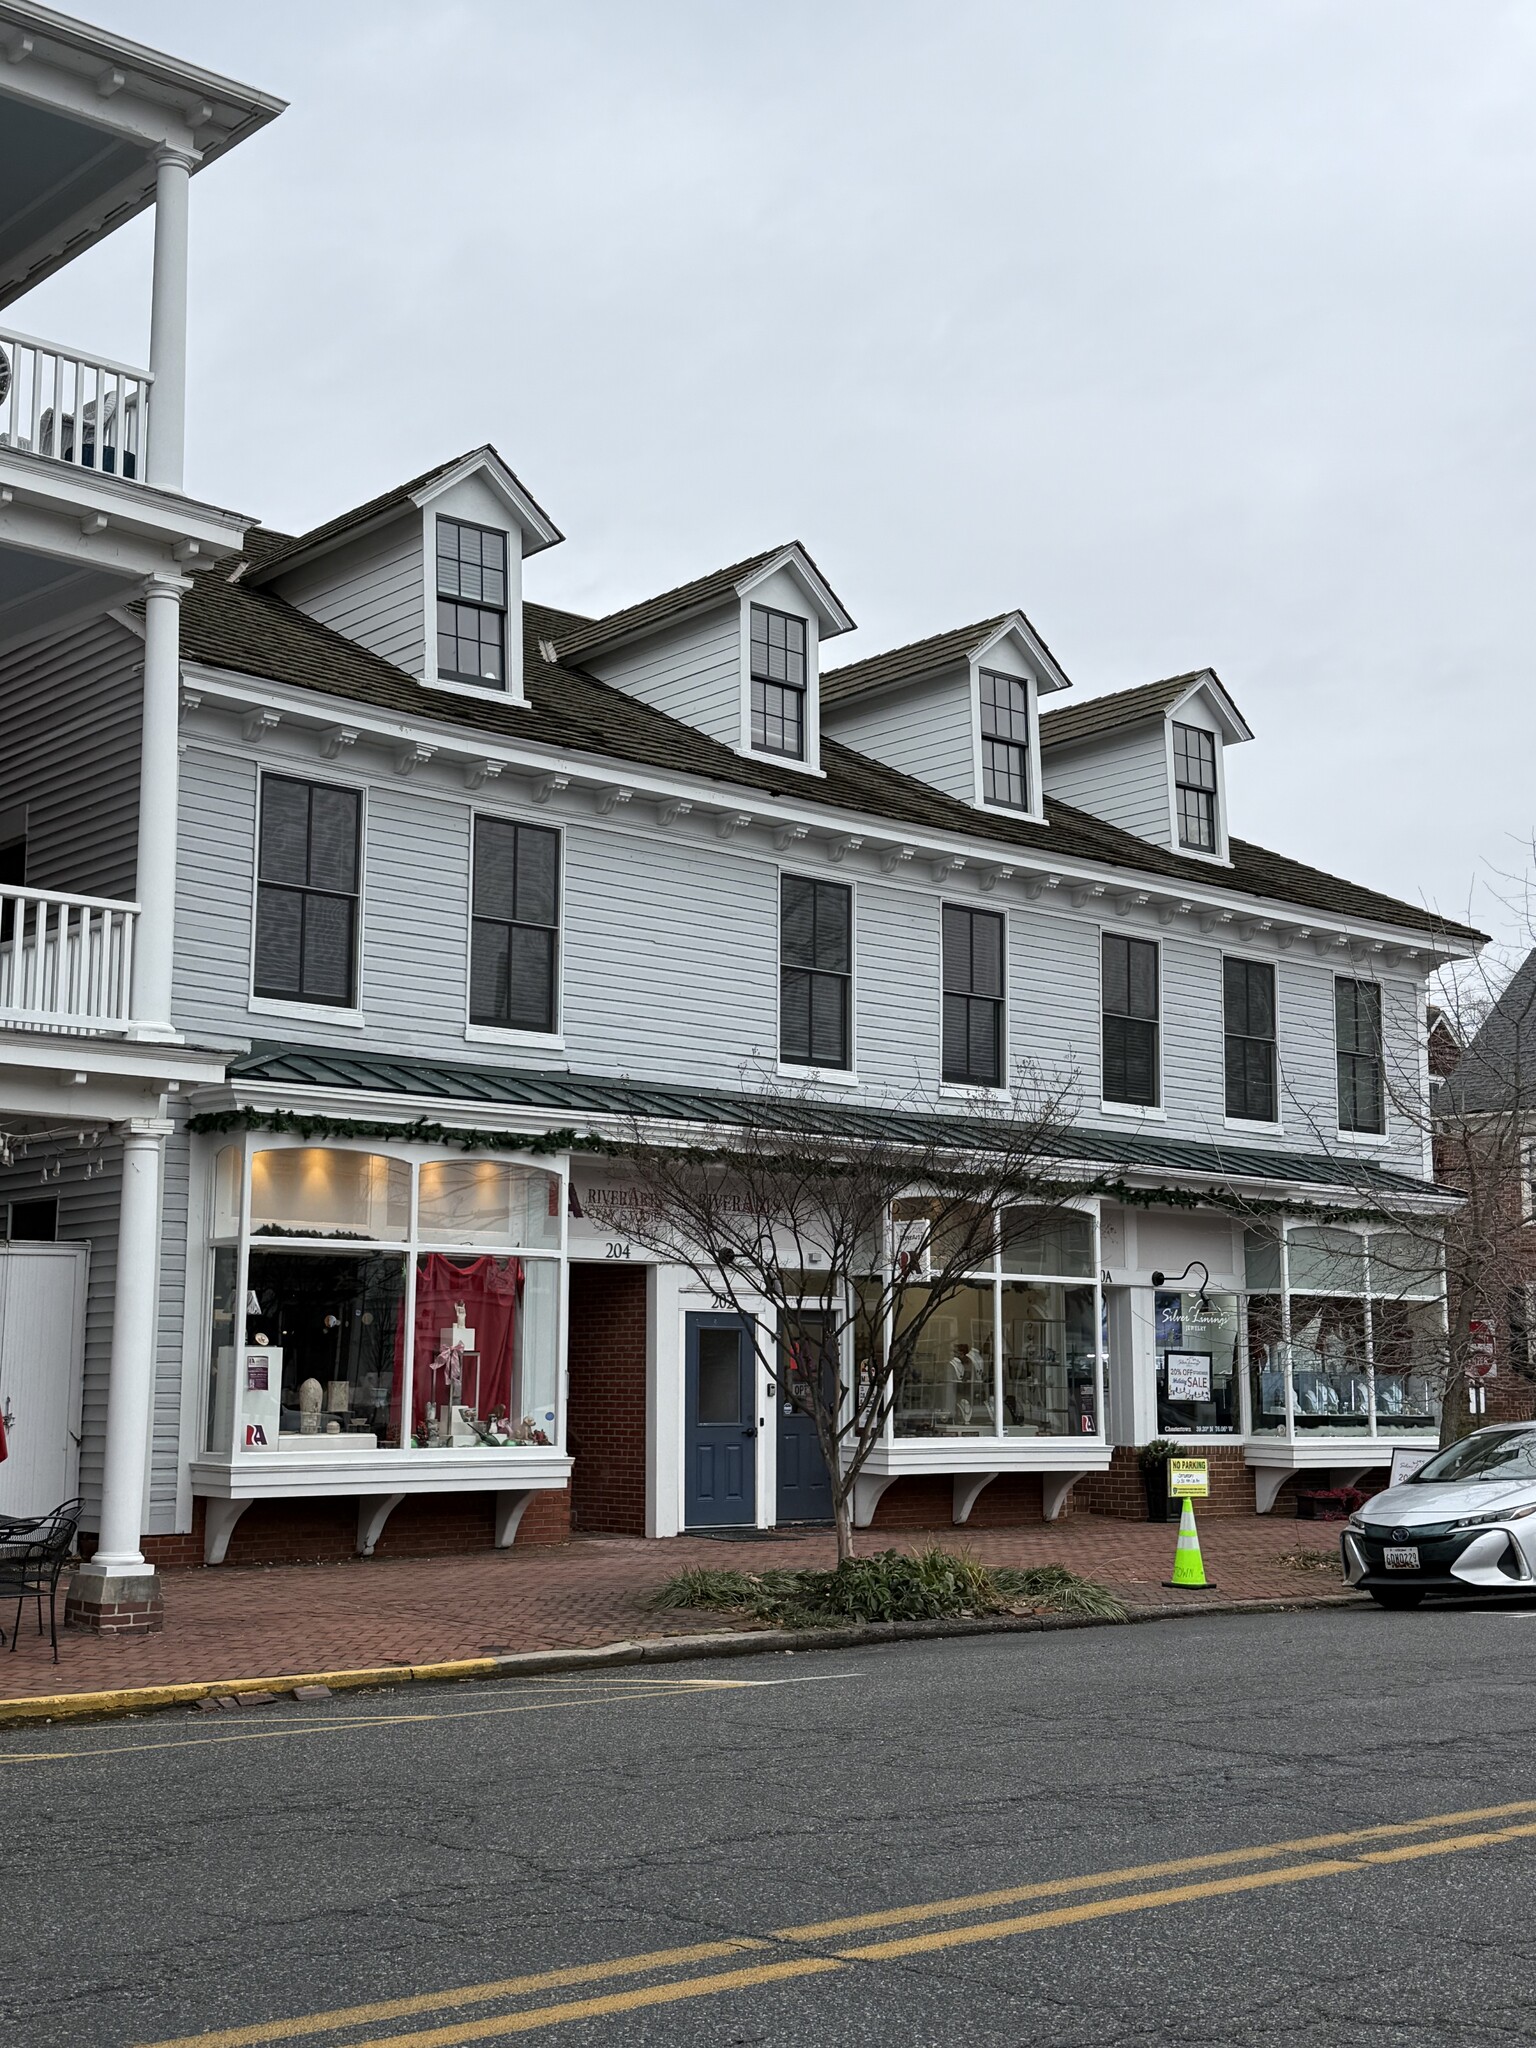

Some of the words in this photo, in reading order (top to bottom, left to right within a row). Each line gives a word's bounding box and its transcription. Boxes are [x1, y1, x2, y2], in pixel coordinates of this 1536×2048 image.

[605, 1242, 631, 1259] 204
[1162, 1308, 1190, 1323] Silver
[1191, 1309, 1231, 1327] Linings
[1170, 1368, 1182, 1376] 20%
[1182, 1368, 1193, 1376] OFF
[1187, 1377, 1207, 1388] SALE
[1172, 1460, 1181, 1469] NO
[1181, 1460, 1206, 1470] PARKING
